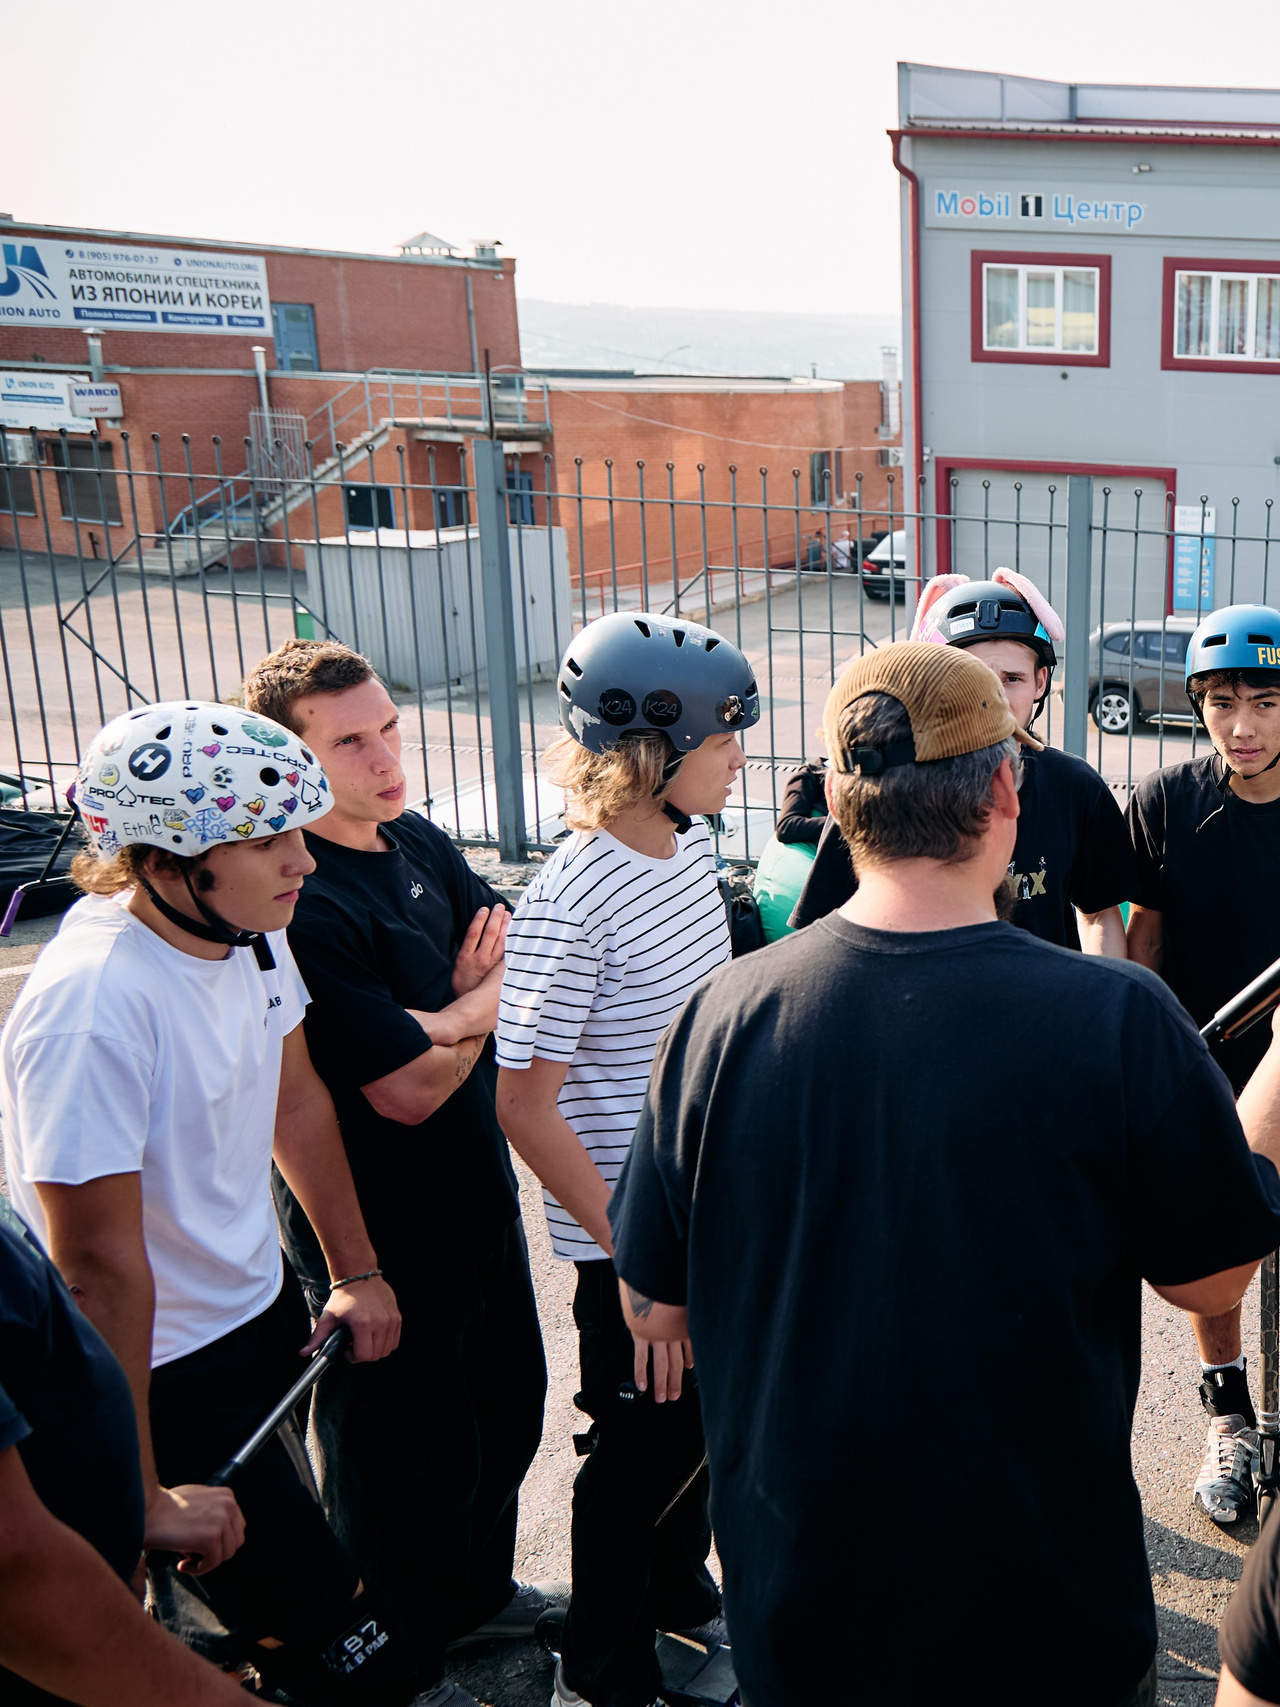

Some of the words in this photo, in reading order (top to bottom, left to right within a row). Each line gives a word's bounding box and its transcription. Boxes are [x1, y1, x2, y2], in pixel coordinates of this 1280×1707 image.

[937, 192, 1009, 216] Mobil
[1021, 195, 1042, 217] 1
[1054, 196, 1142, 228] Центр
[79, 250, 86, 259] 8
[87, 251, 112, 261] (905)
[186, 259, 260, 272] UNIONAUTO.ORG
[69, 269, 161, 285] АВТОМОБИЛИ
[164, 275, 173, 285] И
[176, 277, 261, 291] СПЕЦТЕХНИКА
[71, 285, 97, 301] ИЗ
[102, 287, 184, 306] ЯПОНИИ
[189, 292, 201, 307] И
[205, 293, 263, 310] КОРЕИ
[29, 308, 61, 319] AUTO
[74, 388, 119, 397] WABCO
[600, 700, 633, 715] K24
[645, 700, 678, 718] K24
[89, 787, 115, 799] PRO
[137, 795, 176, 807] TEC
[183, 807, 223, 834] RSC
